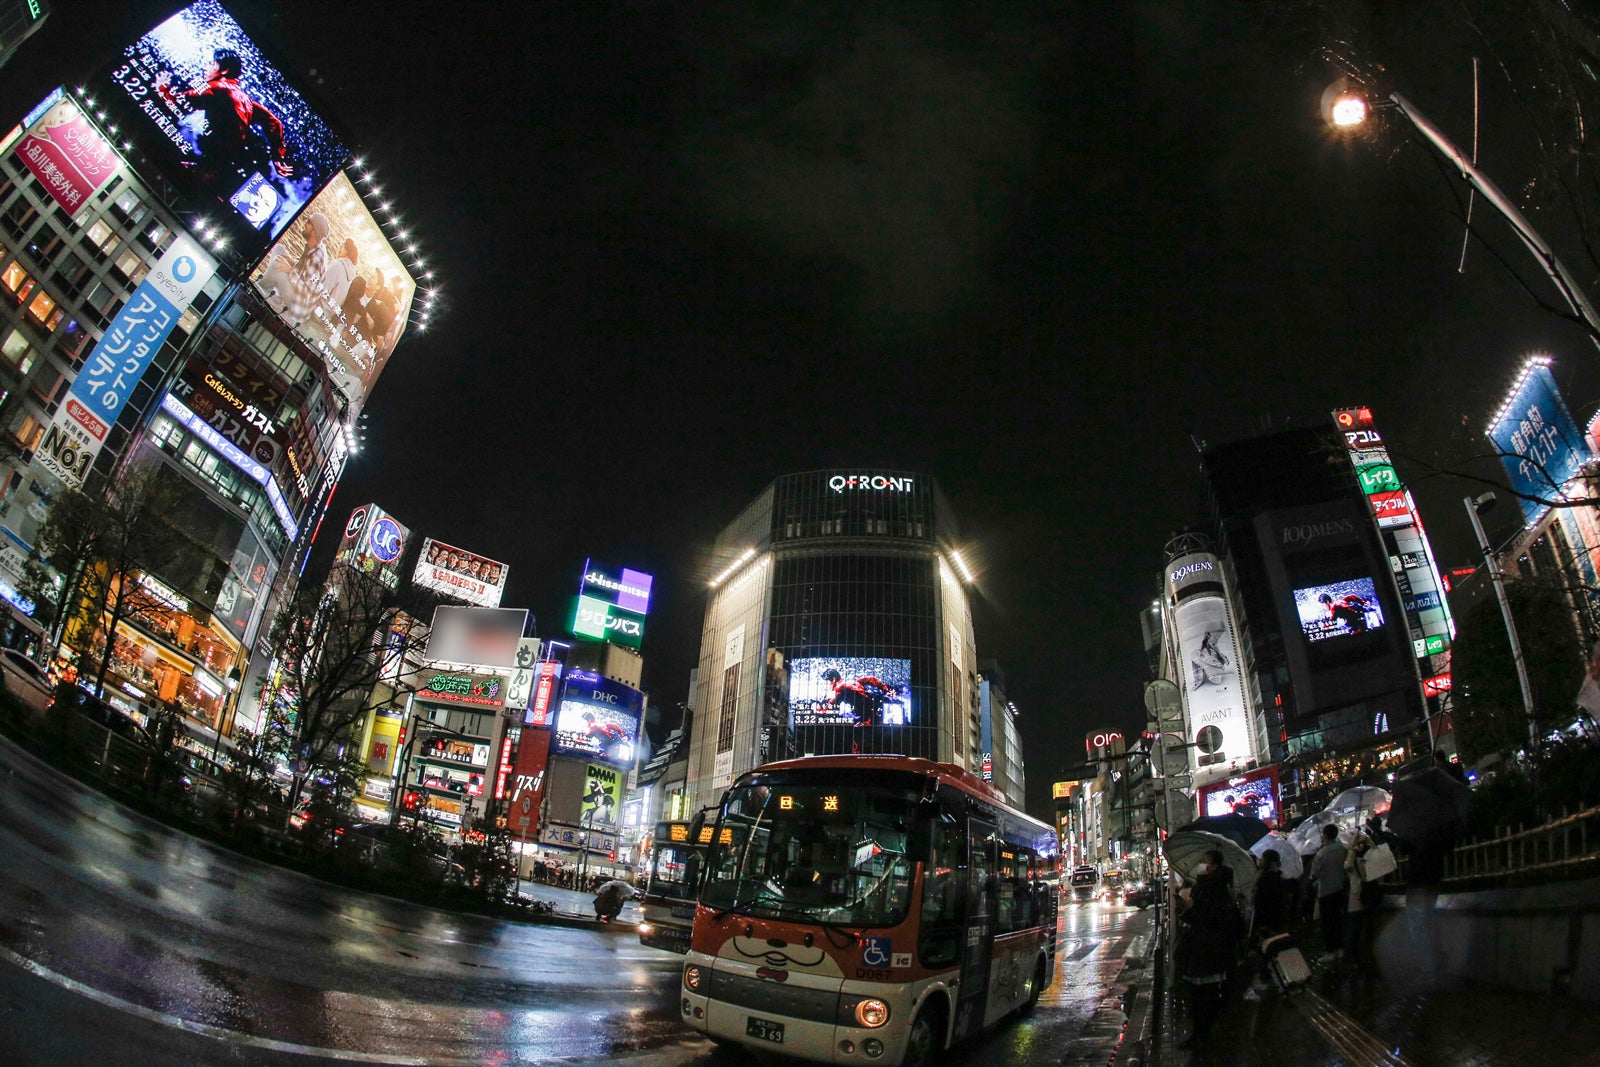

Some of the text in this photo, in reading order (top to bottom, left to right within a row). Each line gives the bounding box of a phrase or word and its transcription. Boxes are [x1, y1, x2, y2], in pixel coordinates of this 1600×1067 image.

[112, 64, 193, 155] 3.22 先行配信決定
[68, 143, 101, 176] クリニック
[77, 132, 112, 169] 品川スキン
[26, 145, 82, 207] 品川美容外科
[155, 270, 188, 305] eyecity
[87, 292, 157, 396] アイシティ
[102, 309, 171, 410] コンタクトの
[324, 350, 347, 375] MUSIC
[175, 378, 194, 397] 7F
[63, 418, 91, 446] 利用者数
[69, 403, 105, 438] 当ビル5階
[208, 408, 251, 447] ガスト
[241, 404, 275, 435] ガスト
[1510, 404, 1545, 455] 龍角散
[190, 421, 252, 468] 英会話イーオン
[1344, 430, 1381, 444] アコム
[35, 451, 81, 489] コンタクトショップ
[1362, 469, 1393, 486] レイク
[829, 475, 913, 494] QFRONT
[1372, 498, 1406, 512] アイフル
[373, 523, 401, 555] UC
[432, 568, 477, 593] LEADERS
[585, 572, 649, 599] Hisamitsu
[580, 608, 640, 636] サロンパス
[592, 690, 618, 705] DHC
[794, 715, 816, 724] 3.22
[1201, 707, 1233, 723] AVANT
[430, 748, 470, 763] Euphoria
[586, 780, 605, 794] FX
[587, 765, 616, 784] DMM
[780, 796, 838, 811] 回送
